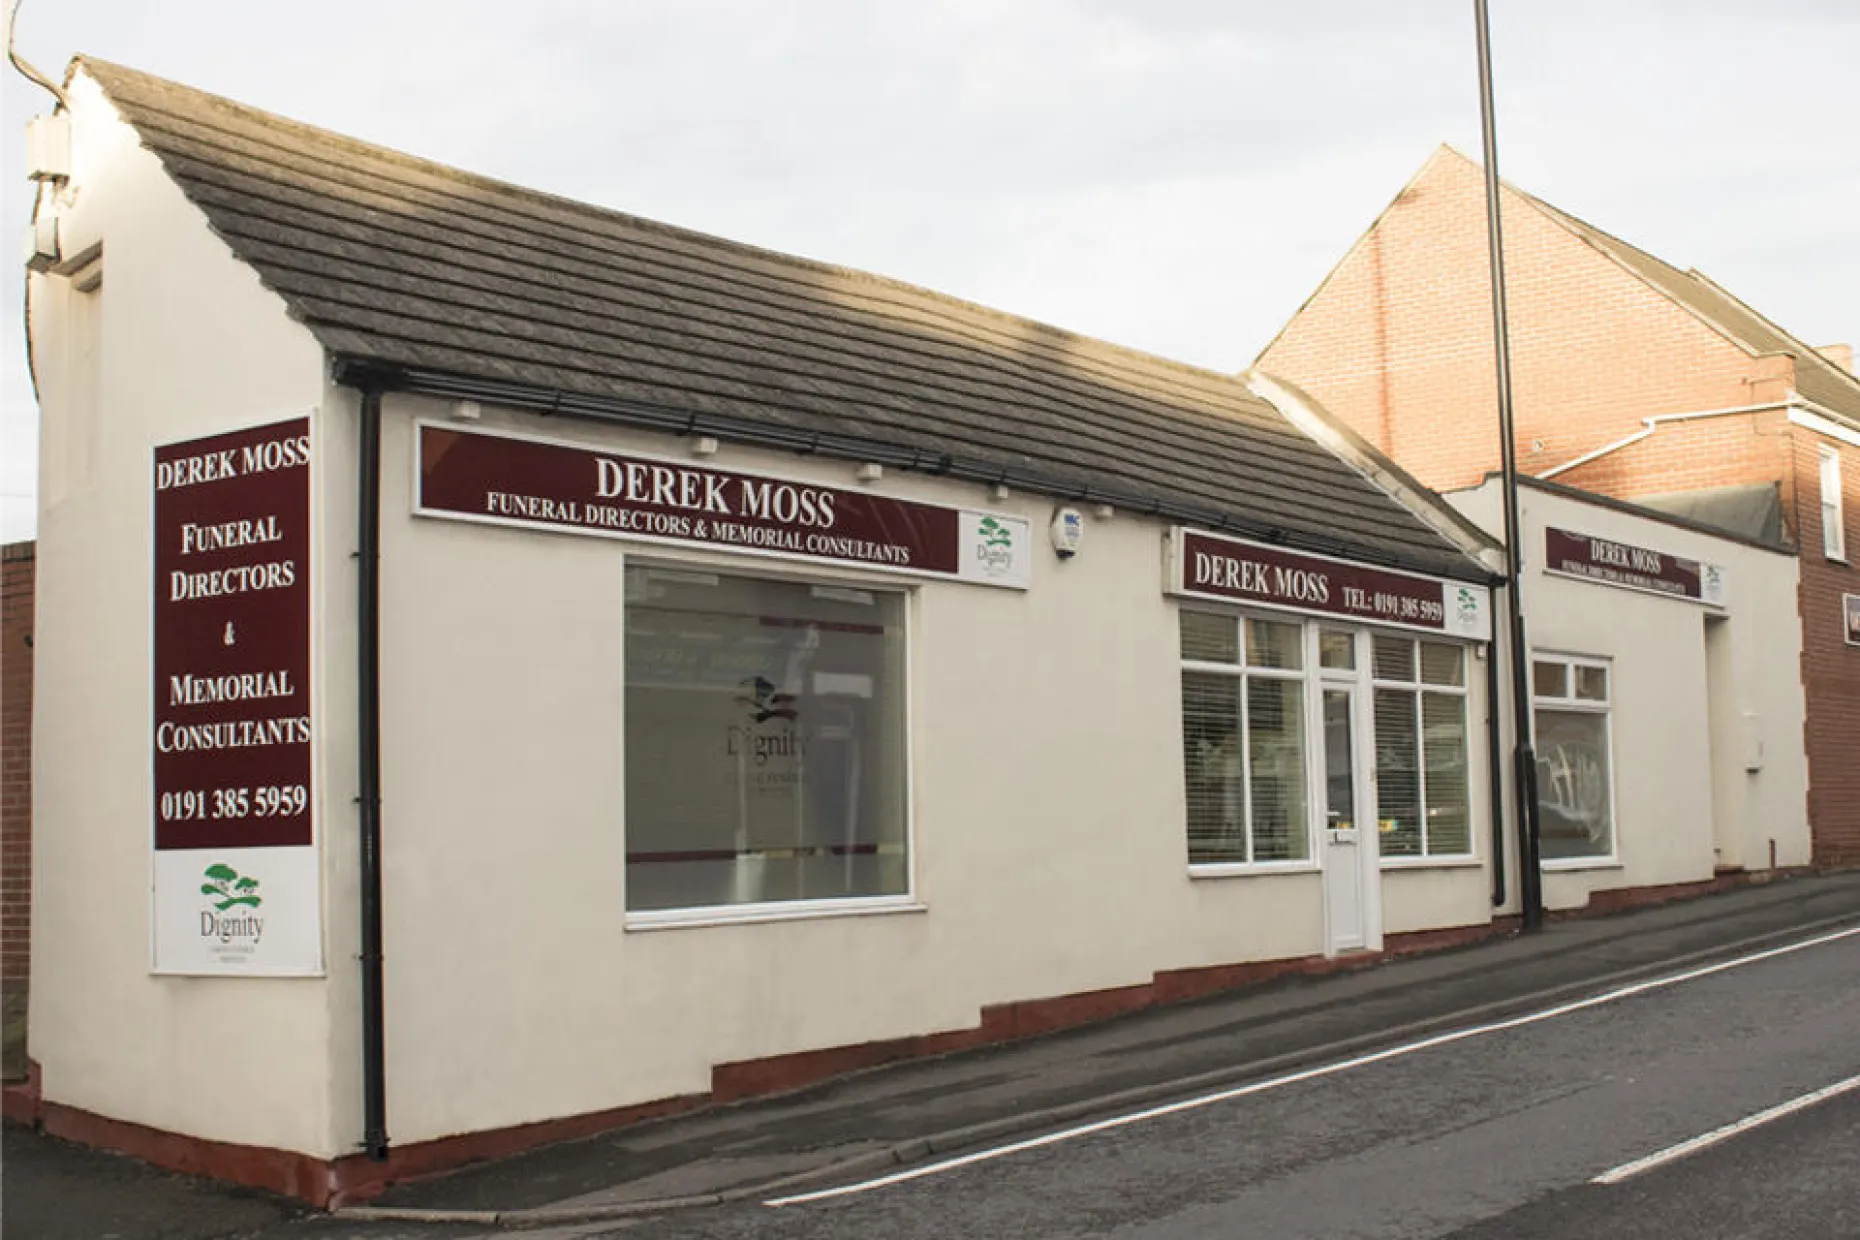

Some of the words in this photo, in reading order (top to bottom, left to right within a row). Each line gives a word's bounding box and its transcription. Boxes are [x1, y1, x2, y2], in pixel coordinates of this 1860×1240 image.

[156, 449, 237, 490] DEREK
[242, 435, 310, 475] MOSS
[594, 457, 732, 514] DEREK
[740, 479, 835, 529] MOSS
[180, 515, 283, 555] FUNERAL
[487, 491, 581, 523] FUNERAL
[585, 503, 691, 537] DIRECTORS
[693, 519, 708, 540] &
[711, 521, 804, 552] MEMORIAL
[806, 534, 909, 565] CONSULTANTS
[170, 559, 295, 602] DIRECTORS
[1194, 552, 1270, 595] DEREK
[1275, 566, 1330, 603] MOSS
[1342, 586, 1373, 611] TEL:
[223, 620, 236, 647] &
[170, 669, 295, 707] MEMORIAL
[156, 716, 310, 753] CONSULTANTS
[161, 790, 206, 821] 0191
[212, 787, 249, 819] 385
[254, 784, 307, 817] 5959
[200, 910, 264, 944] Dignity
